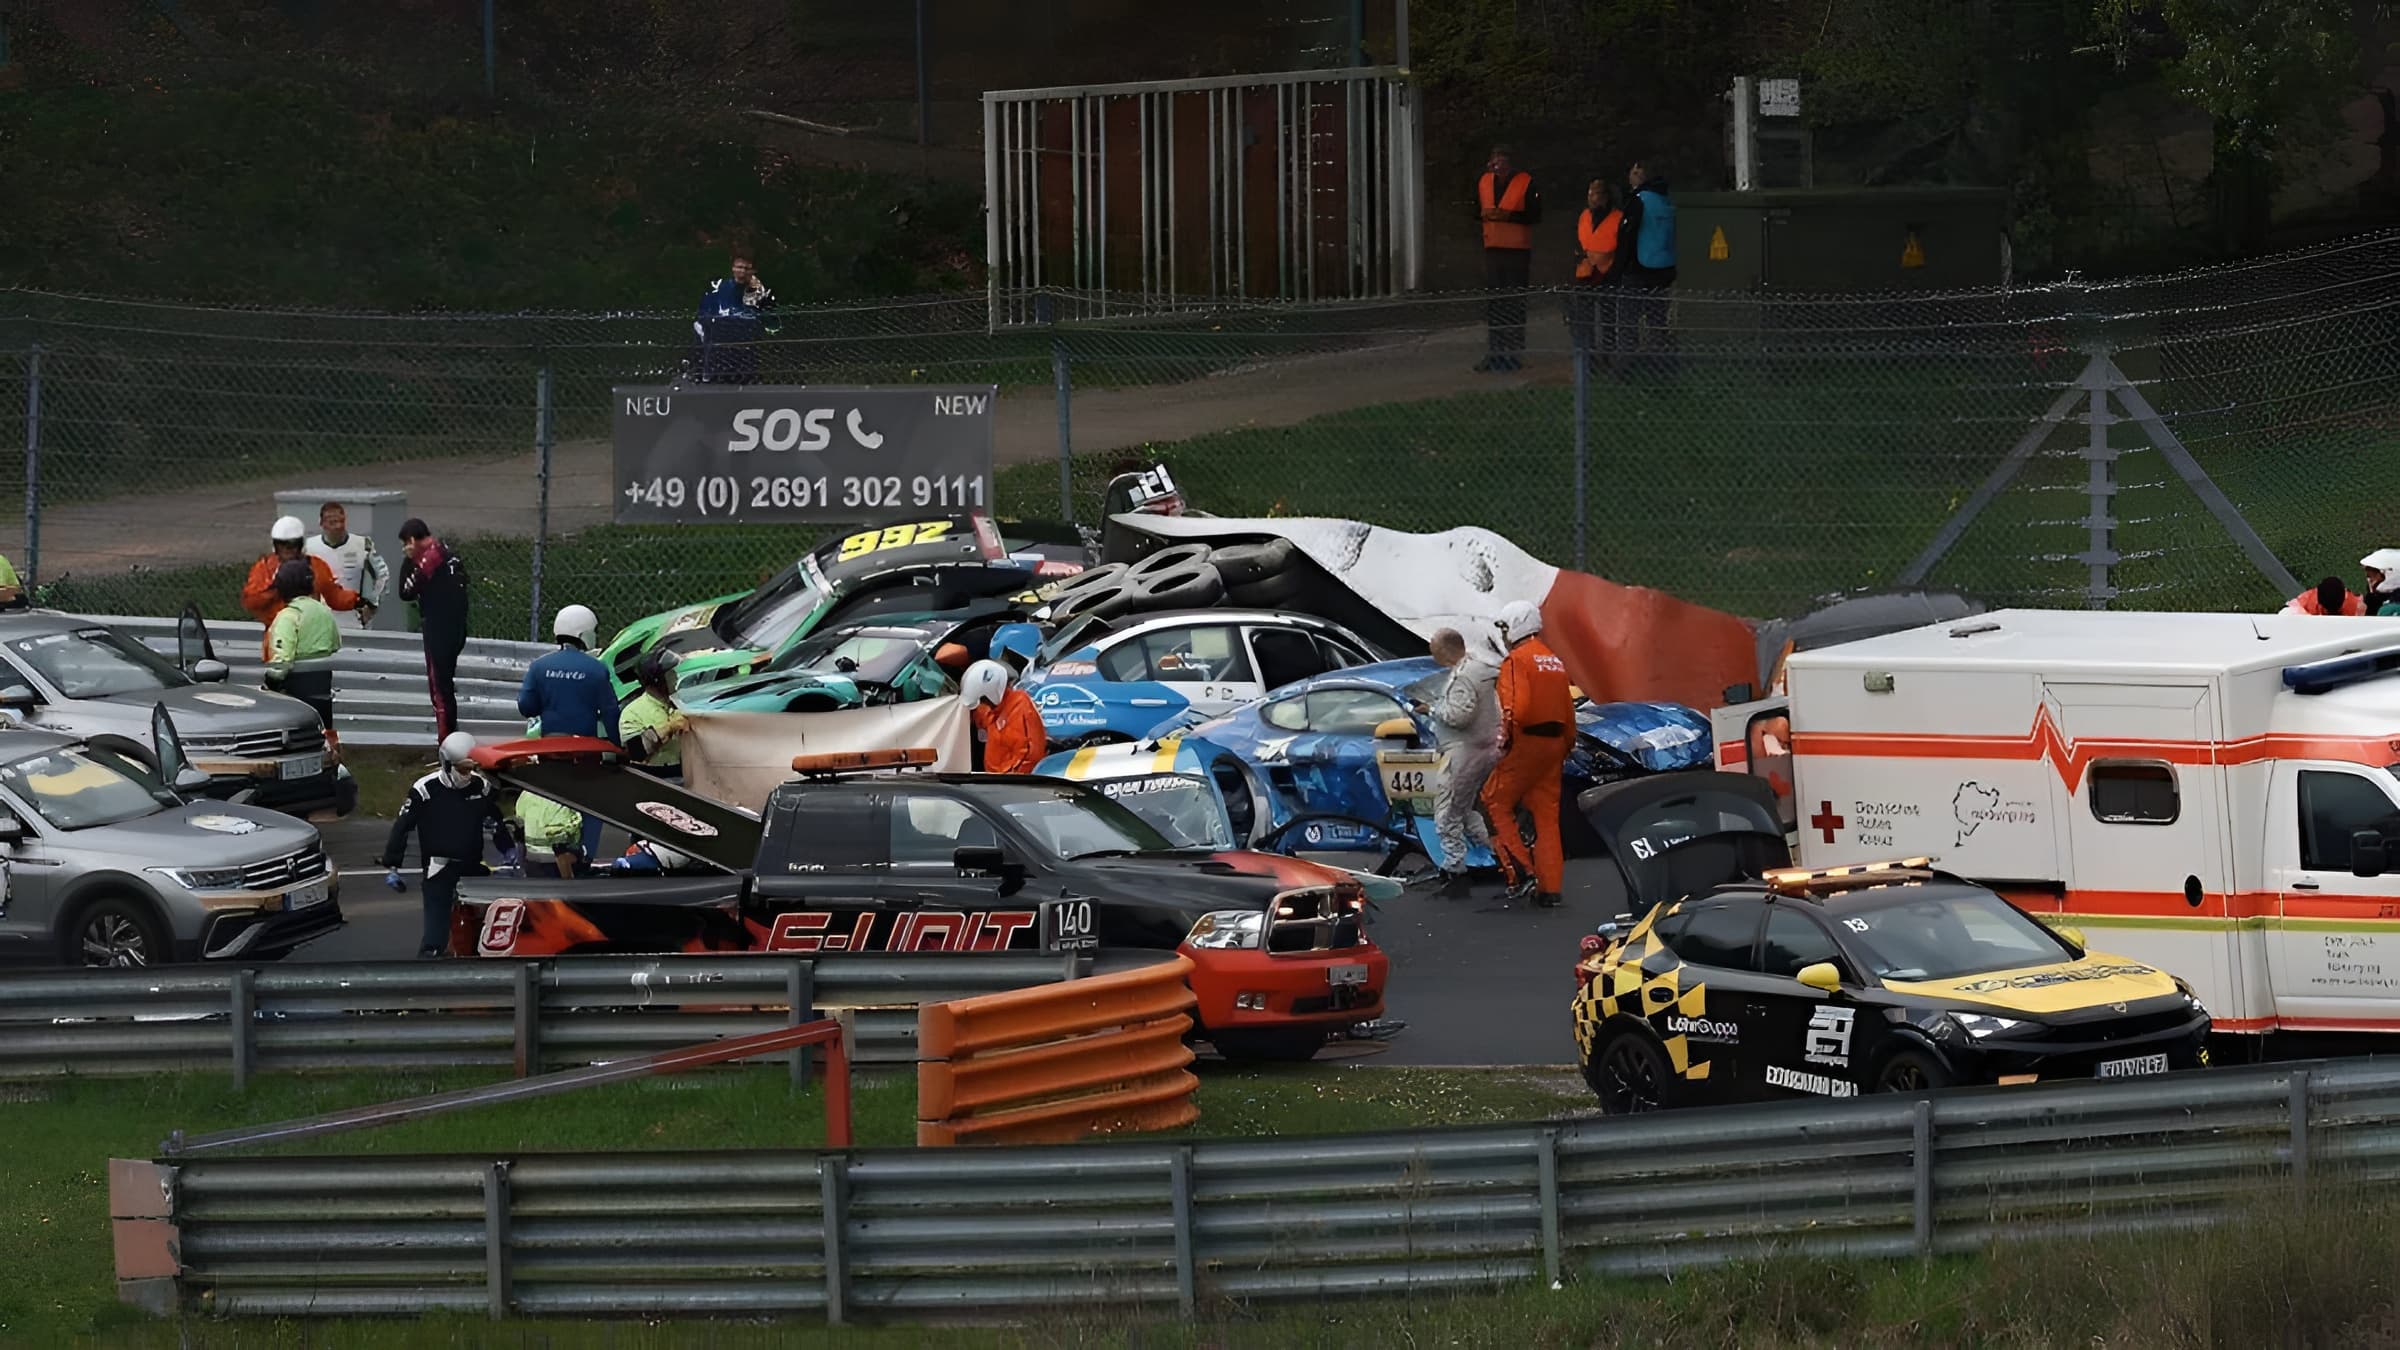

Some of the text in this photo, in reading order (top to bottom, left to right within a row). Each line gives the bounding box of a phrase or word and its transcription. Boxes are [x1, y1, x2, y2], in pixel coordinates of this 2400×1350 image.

[626, 396, 671, 416] NEU
[934, 395, 987, 416] NEW
[728, 408, 835, 451] SOS
[625, 474, 984, 516] +49 (0) 2691 302 9111
[837, 521, 953, 563] 992
[1055, 902, 1092, 937] 140
